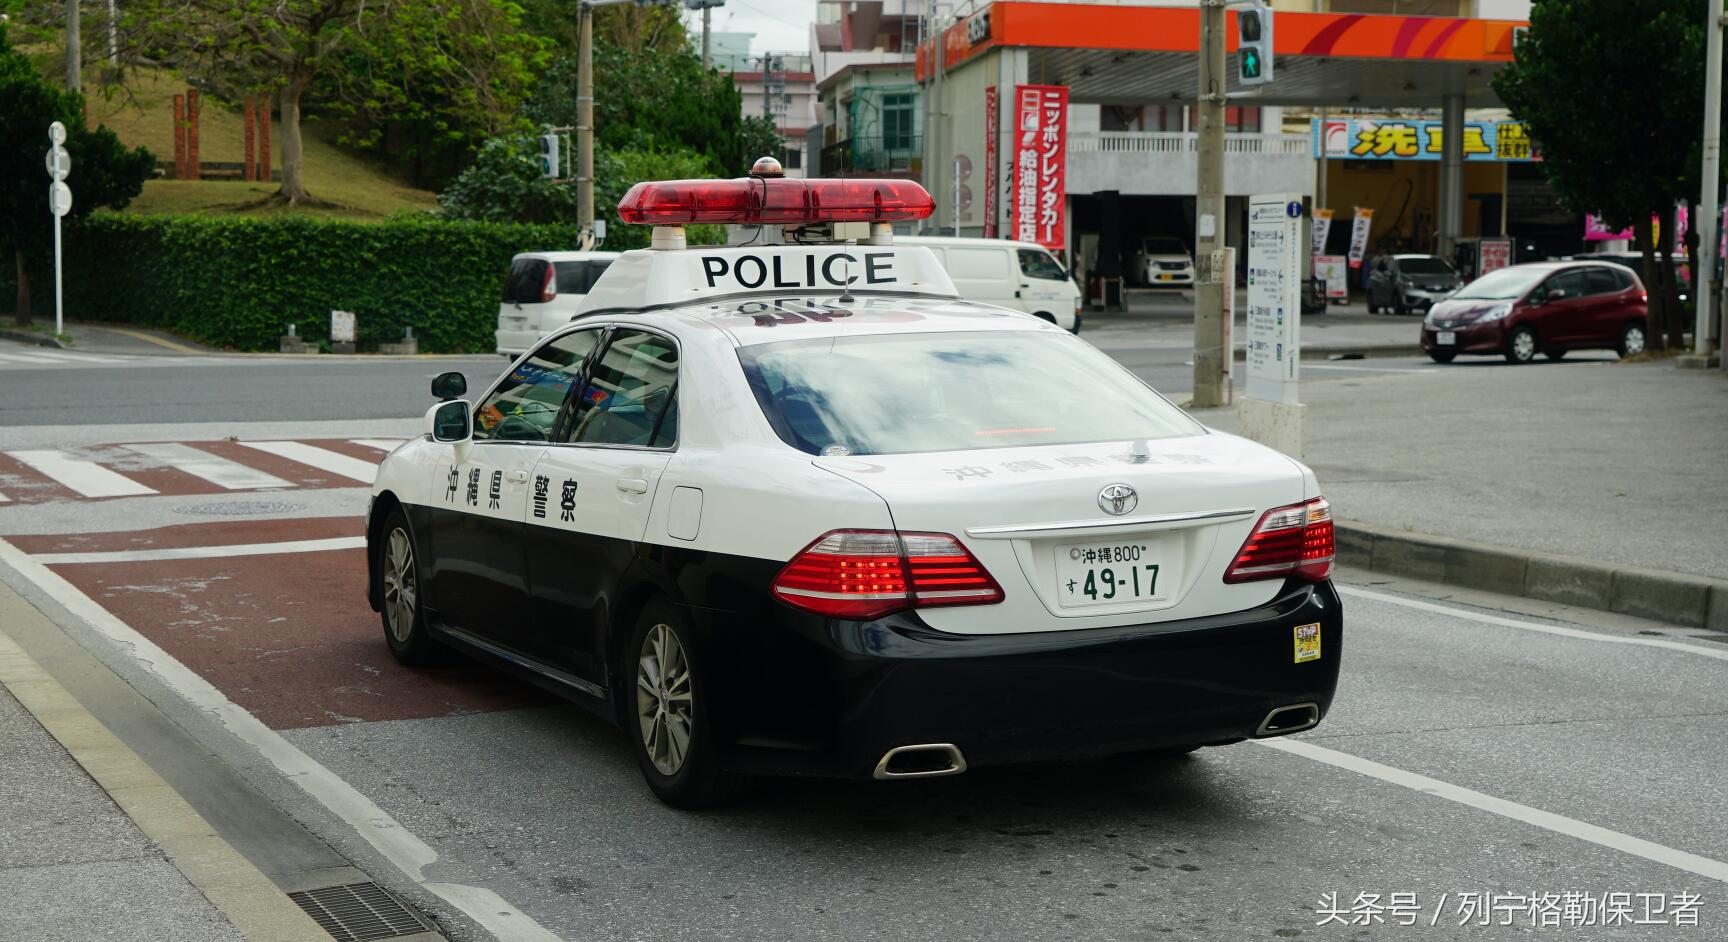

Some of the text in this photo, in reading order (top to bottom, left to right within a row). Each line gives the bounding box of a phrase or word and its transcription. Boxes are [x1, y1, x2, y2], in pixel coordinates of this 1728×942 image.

[1352, 123, 1492, 158] 洗車
[1041, 91, 1061, 243] ニッポンレンタカー
[1018, 149, 1039, 243] 給油指定店
[701, 252, 898, 289] POLICE
[446, 464, 578, 523] 沖縄県警察
[1066, 564, 1160, 600] す 49-17
